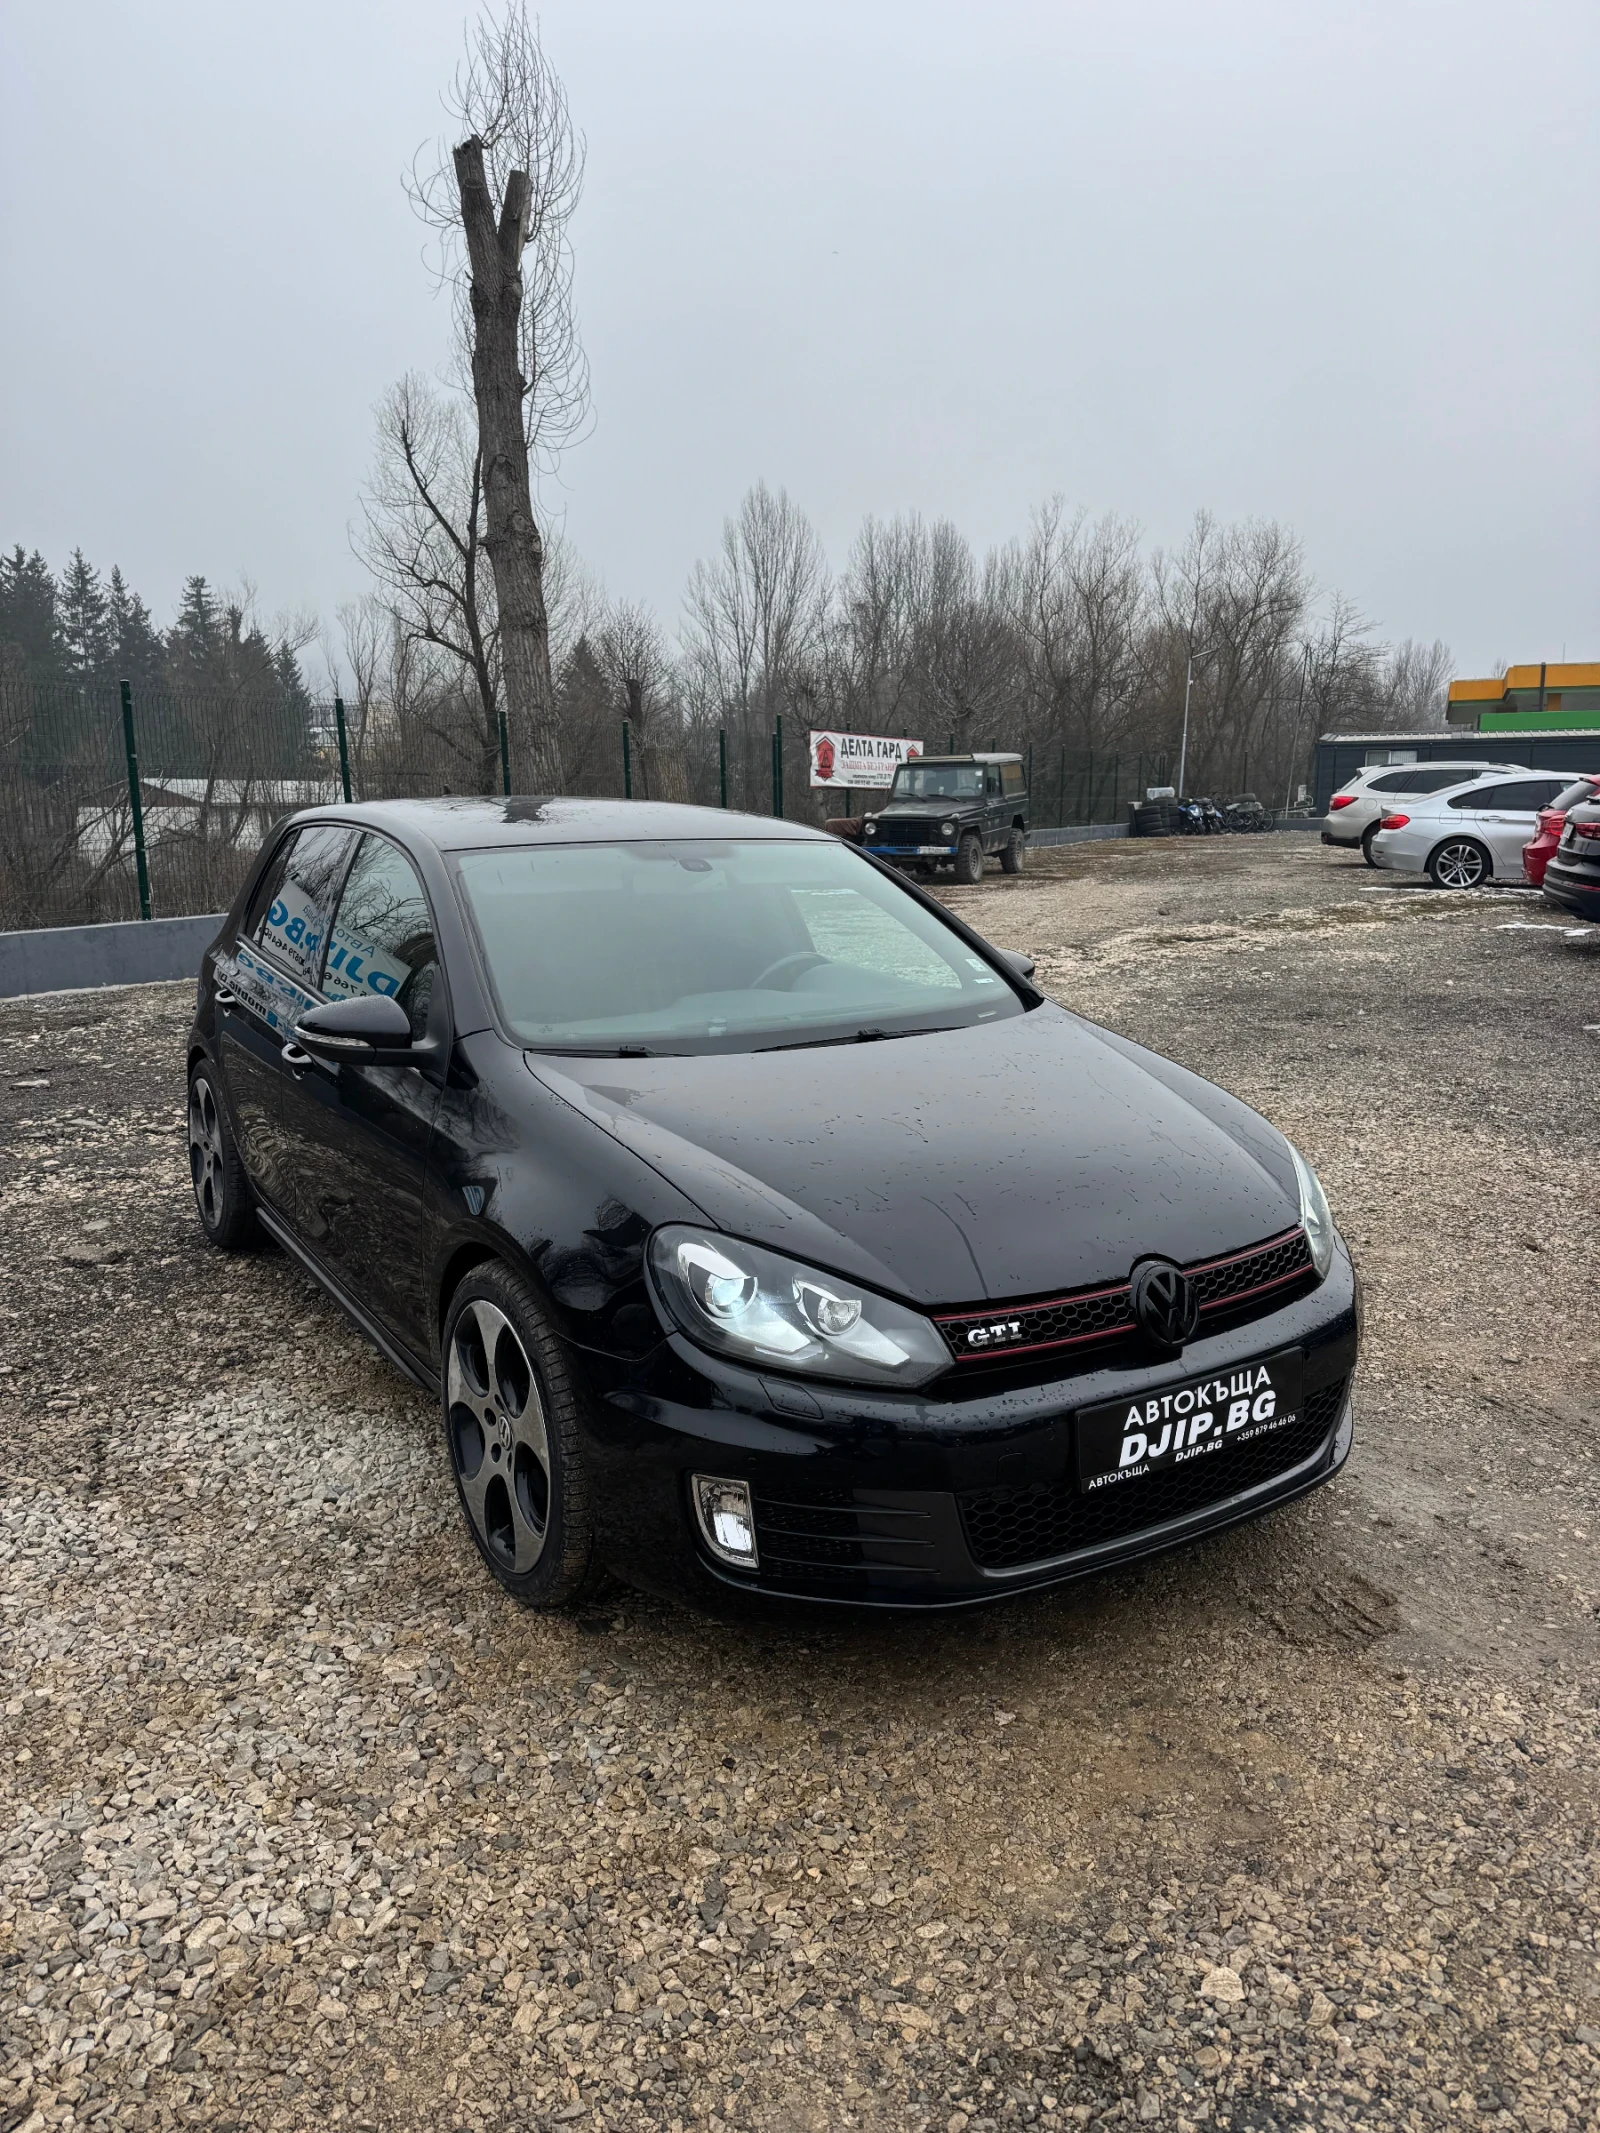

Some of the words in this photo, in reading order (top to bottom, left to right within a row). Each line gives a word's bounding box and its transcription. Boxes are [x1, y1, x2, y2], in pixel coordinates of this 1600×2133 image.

[841, 738, 874, 759] ДЕЛТА
[877, 741, 902, 762] ГАРД
[967, 1321, 1022, 1348] GTI
[1123, 1365, 1272, 1431] АВТОКЪЩА
[1118, 1390, 1277, 1468] DJIP.BG
[1237, 1429, 1254, 1442] +359
[1255, 1424, 1268, 1436] 879
[1268, 1420, 1278, 1430] 46
[1278, 1416, 1287, 1426] 46
[1174, 1439, 1223, 1463] DJIP.BG
[1088, 1463, 1150, 1490] АВТОКЪЩА
